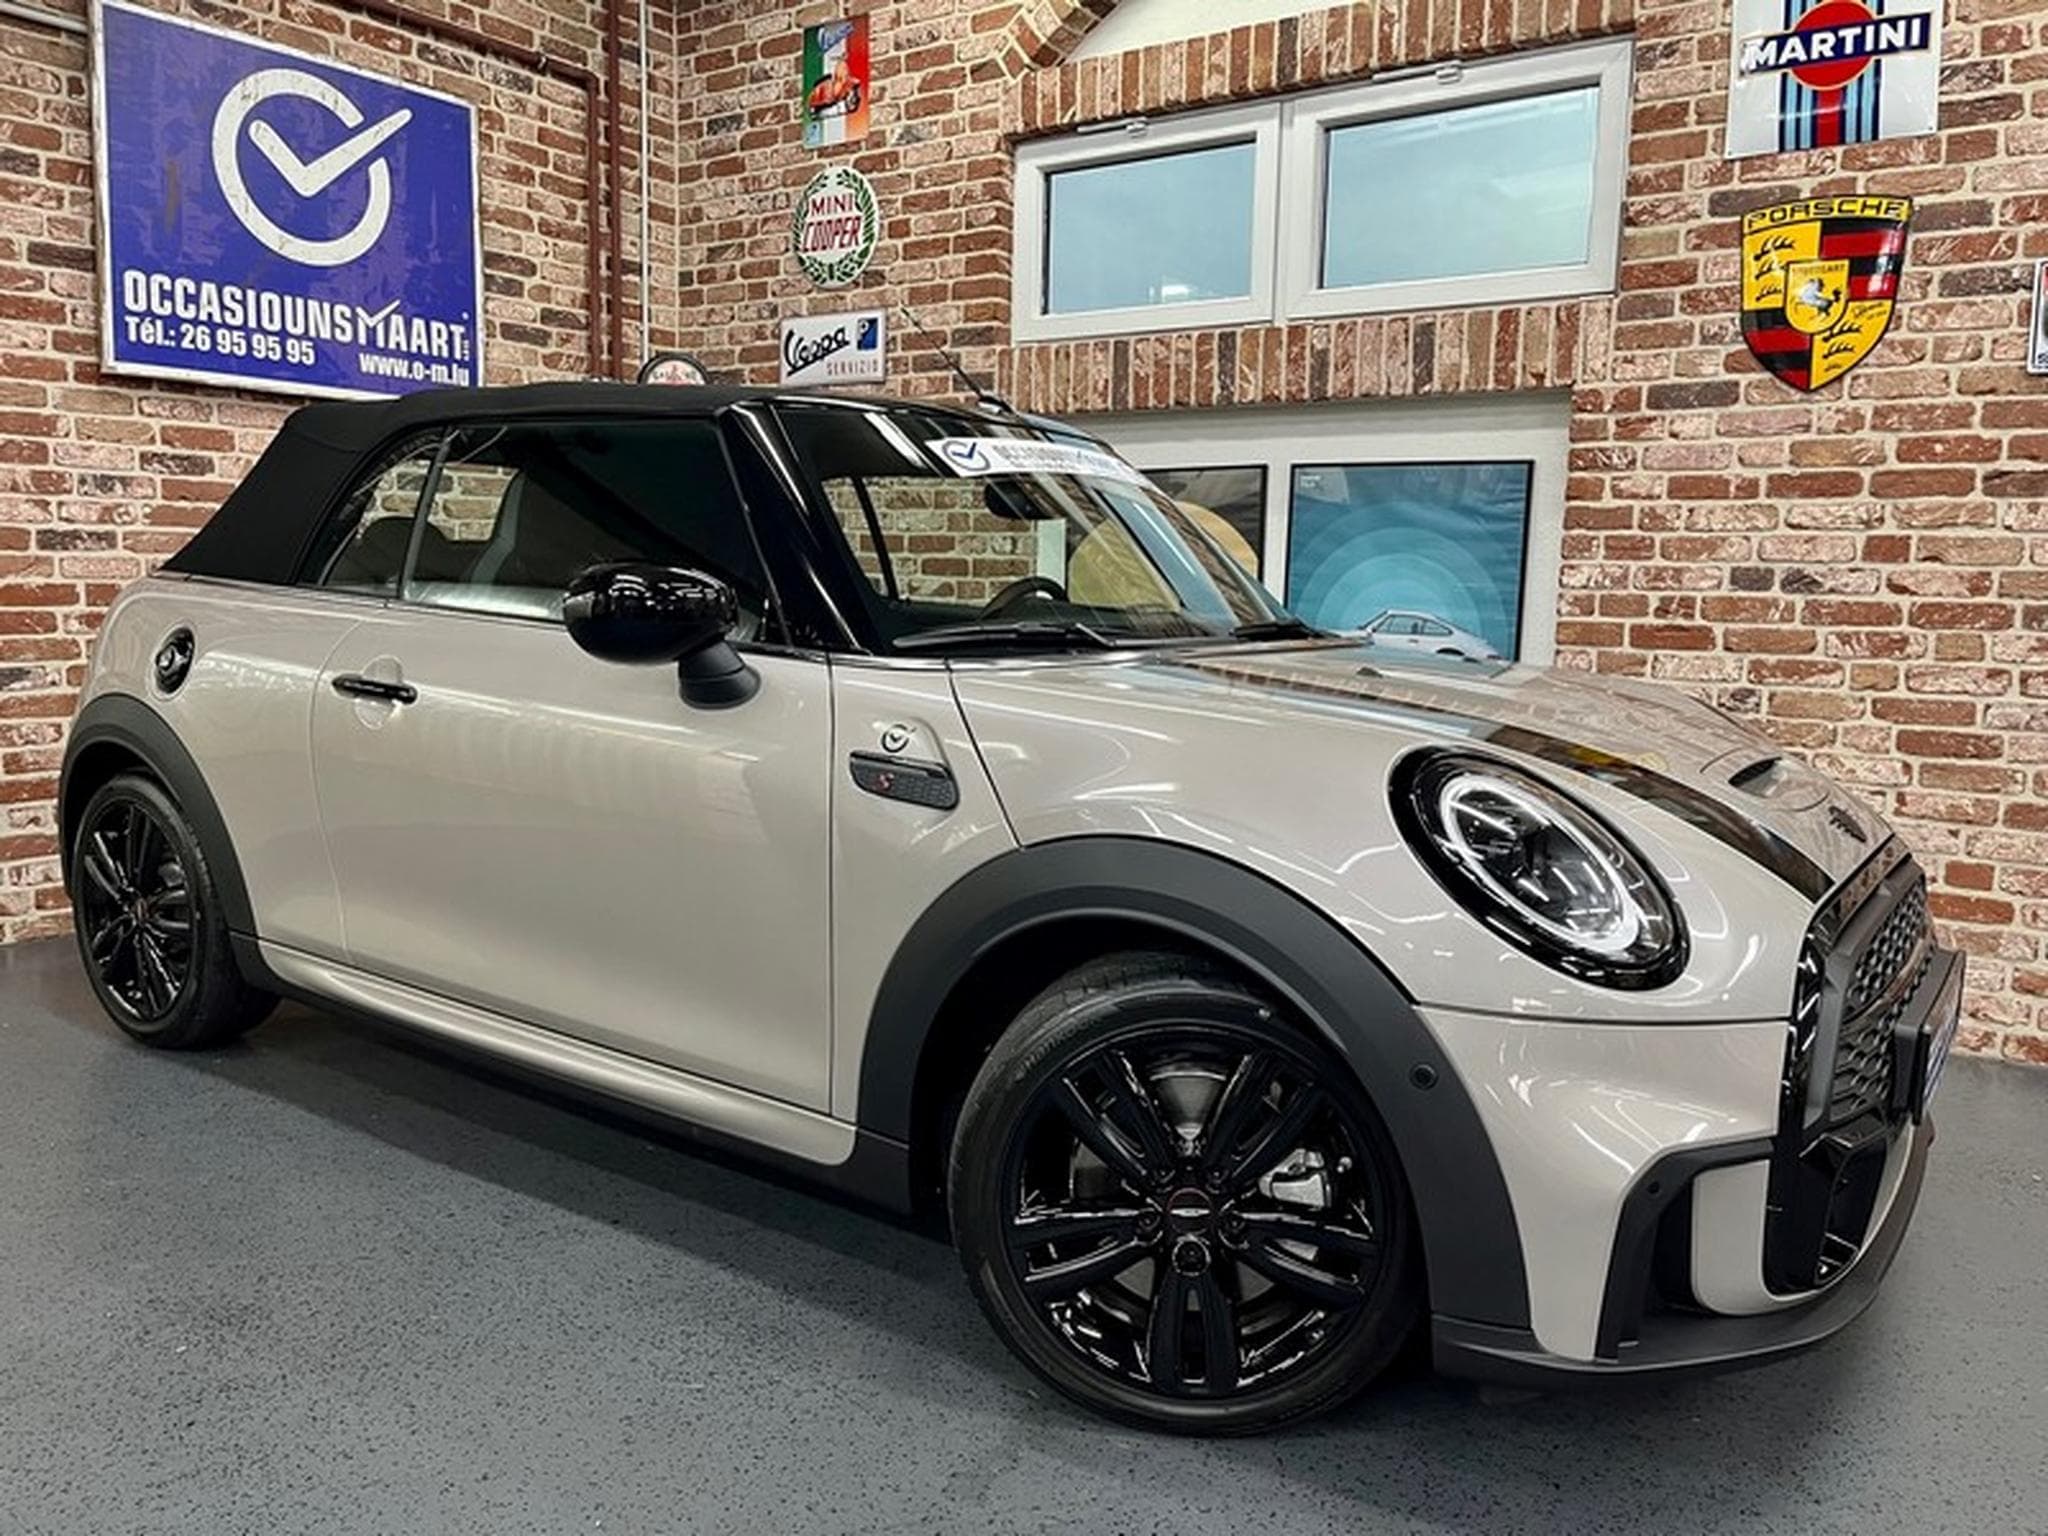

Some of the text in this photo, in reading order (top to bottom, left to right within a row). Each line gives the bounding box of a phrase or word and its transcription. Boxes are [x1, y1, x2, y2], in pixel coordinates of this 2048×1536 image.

[1744, 17, 1921, 71] MARTINI
[811, 193, 853, 216] MINI
[1748, 199, 1905, 229] PORSCHE
[803, 215, 862, 253] COOPER
[123, 269, 465, 361] OCCASIOUNSMAART
[125, 315, 315, 366] Tél.: 26 95 95 95
[784, 326, 850, 377] Vespa
[359, 353, 470, 387] www.o-m.lu
